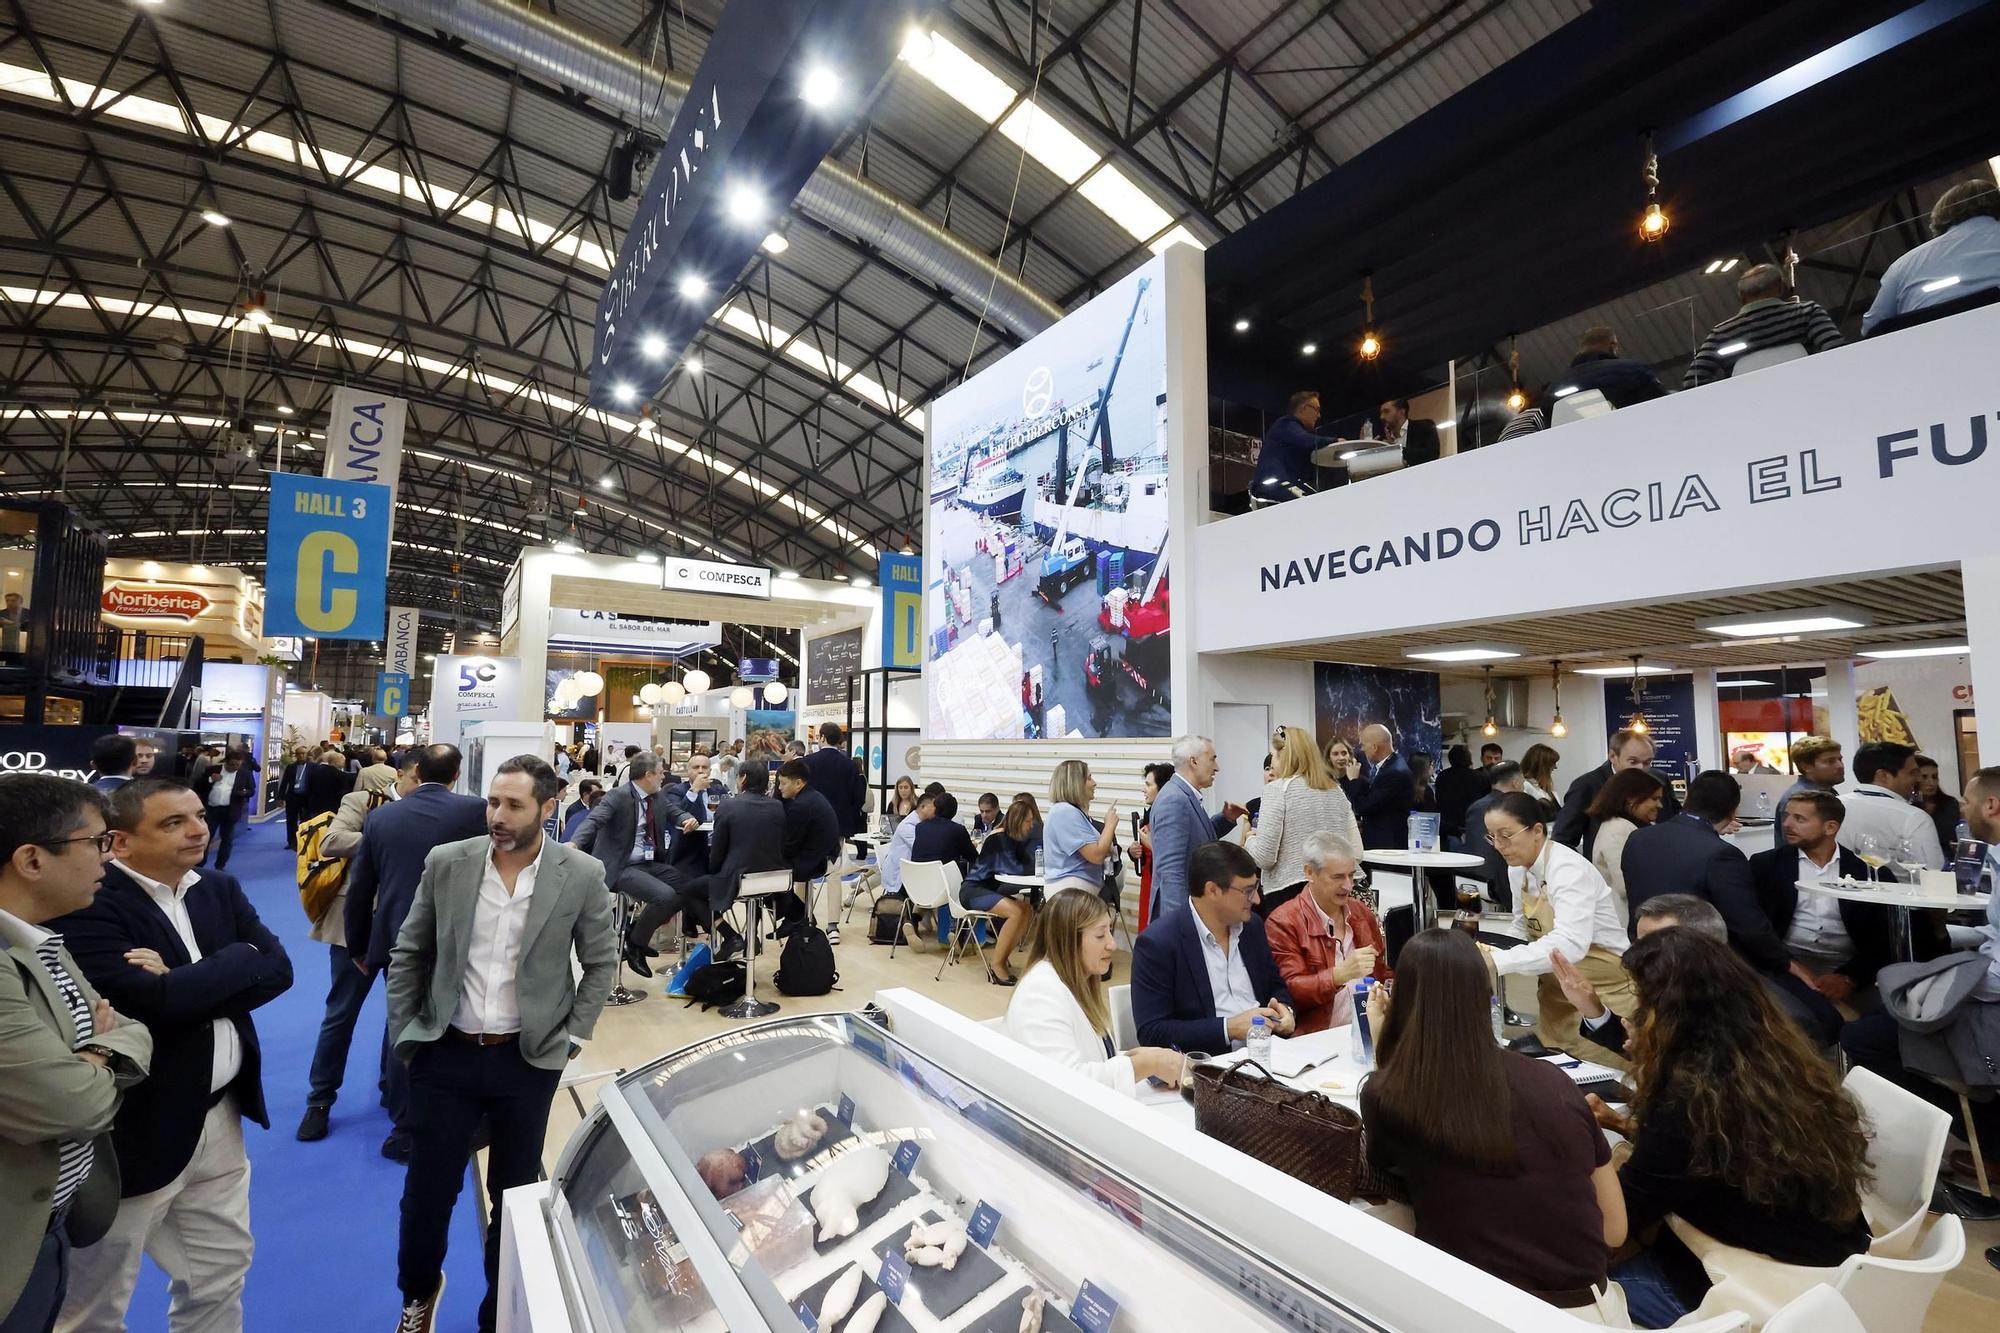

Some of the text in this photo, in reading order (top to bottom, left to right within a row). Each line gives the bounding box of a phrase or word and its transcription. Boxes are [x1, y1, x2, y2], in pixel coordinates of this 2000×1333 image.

[344, 402, 386, 482] NCA
[295, 491, 367, 519] HALL 3
[1260, 411, 2000, 592] NAVEGANDO HACIA EL FU
[295, 530, 359, 633] C
[699, 570, 762, 587] COMPESCA
[892, 564, 919, 582] HALL
[109, 591, 201, 609] Noribérica
[383, 687, 401, 715] C
[0, 751, 46, 770] OD
